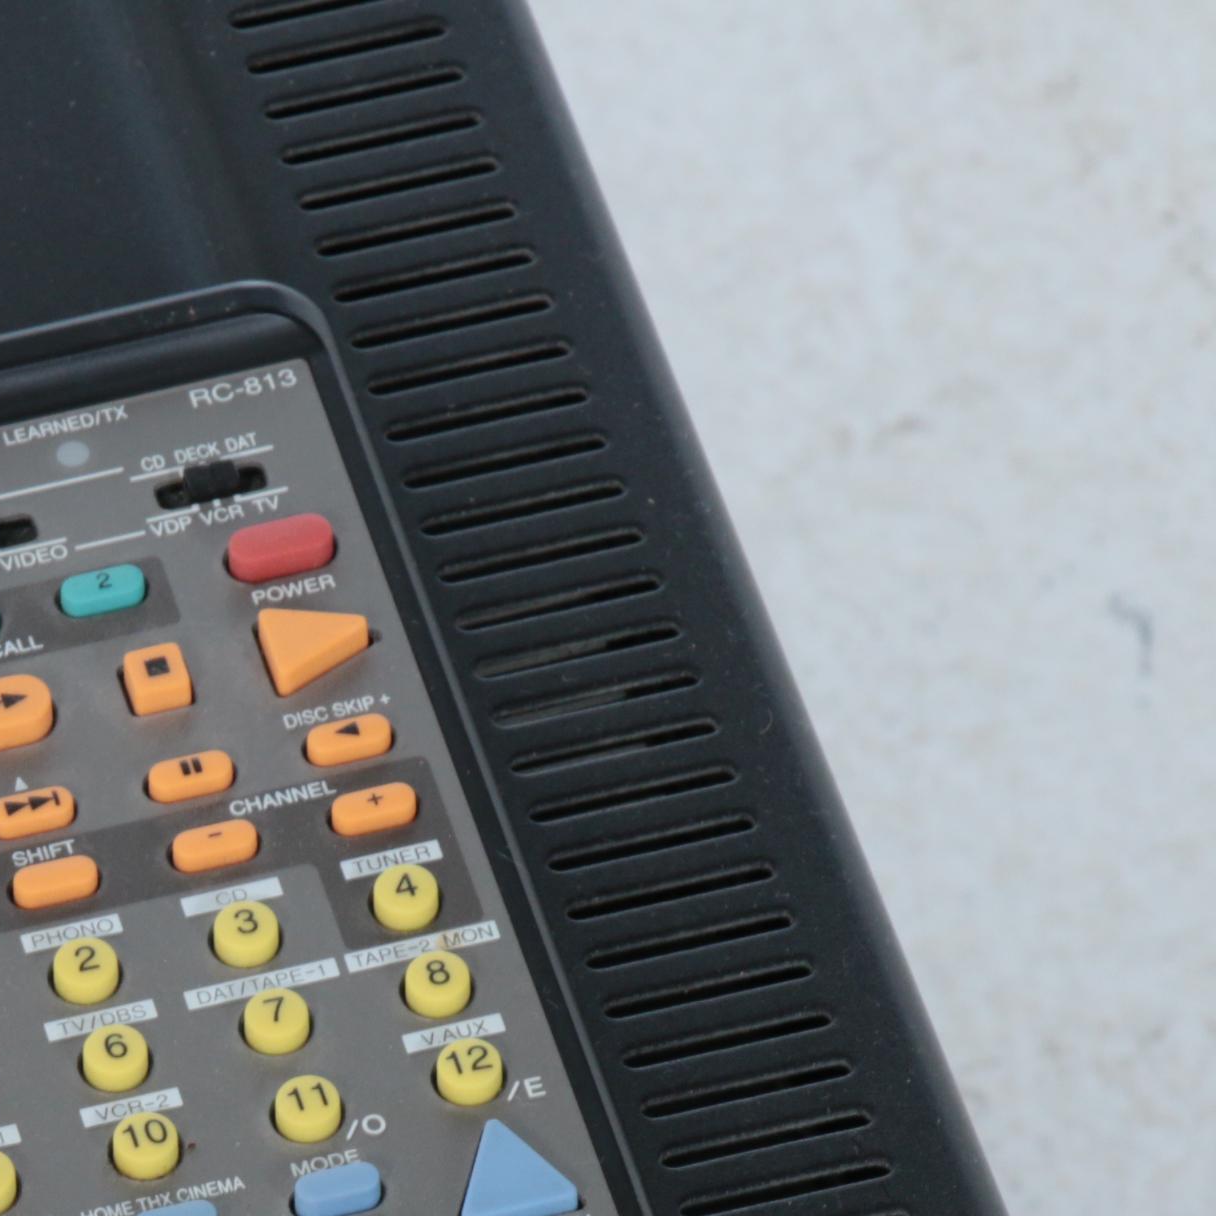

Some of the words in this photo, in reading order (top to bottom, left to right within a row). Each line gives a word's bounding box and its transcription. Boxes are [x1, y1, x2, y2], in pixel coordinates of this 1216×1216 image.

[188, 368, 298, 409] RC-813
[3, 405, 129, 447] LEARNED/TX
[141, 453, 165, 472] CD
[174, 441, 220, 465] DECK
[225, 433, 258, 455] DAT
[148, 516, 193, 538] VDP
[199, 505, 245, 527] VCR
[252, 496, 280, 515] TV
[97, 572, 112, 589] 2
[251, 574, 337, 606] POWER
[284, 704, 330, 731] DISC
[332, 695, 375, 718] SKIP
[379, 693, 392, 706] +
[229, 780, 337, 817] CHANNEL
[11, 839, 76, 868] SHIFT
[352, 845, 432, 874] TUNER
[215, 888, 248, 906] CD
[395, 873, 418, 898] 4
[31, 918, 114, 948] PHONO
[233, 909, 259, 934] 3
[75, 945, 100, 973] 2
[352, 939, 430, 969] TAPE-2
[442, 924, 494, 950] MON
[196, 963, 328, 1005] DAT/TAPE-1
[425, 960, 451, 986] 8
[57, 1004, 147, 1036] TV/DBS
[263, 996, 285, 1023] 7
[104, 1033, 128, 1059] 6
[445, 1045, 494, 1075] 12
[506, 1076, 547, 1102] /E
[95, 1094, 171, 1121] VCR-2
[287, 1083, 329, 1112] 11
[122, 1118, 168, 1149] 10
[290, 1149, 361, 1177] MODE
[136, 1192, 172, 1212] THX
[176, 1176, 246, 1203] CINEMA
